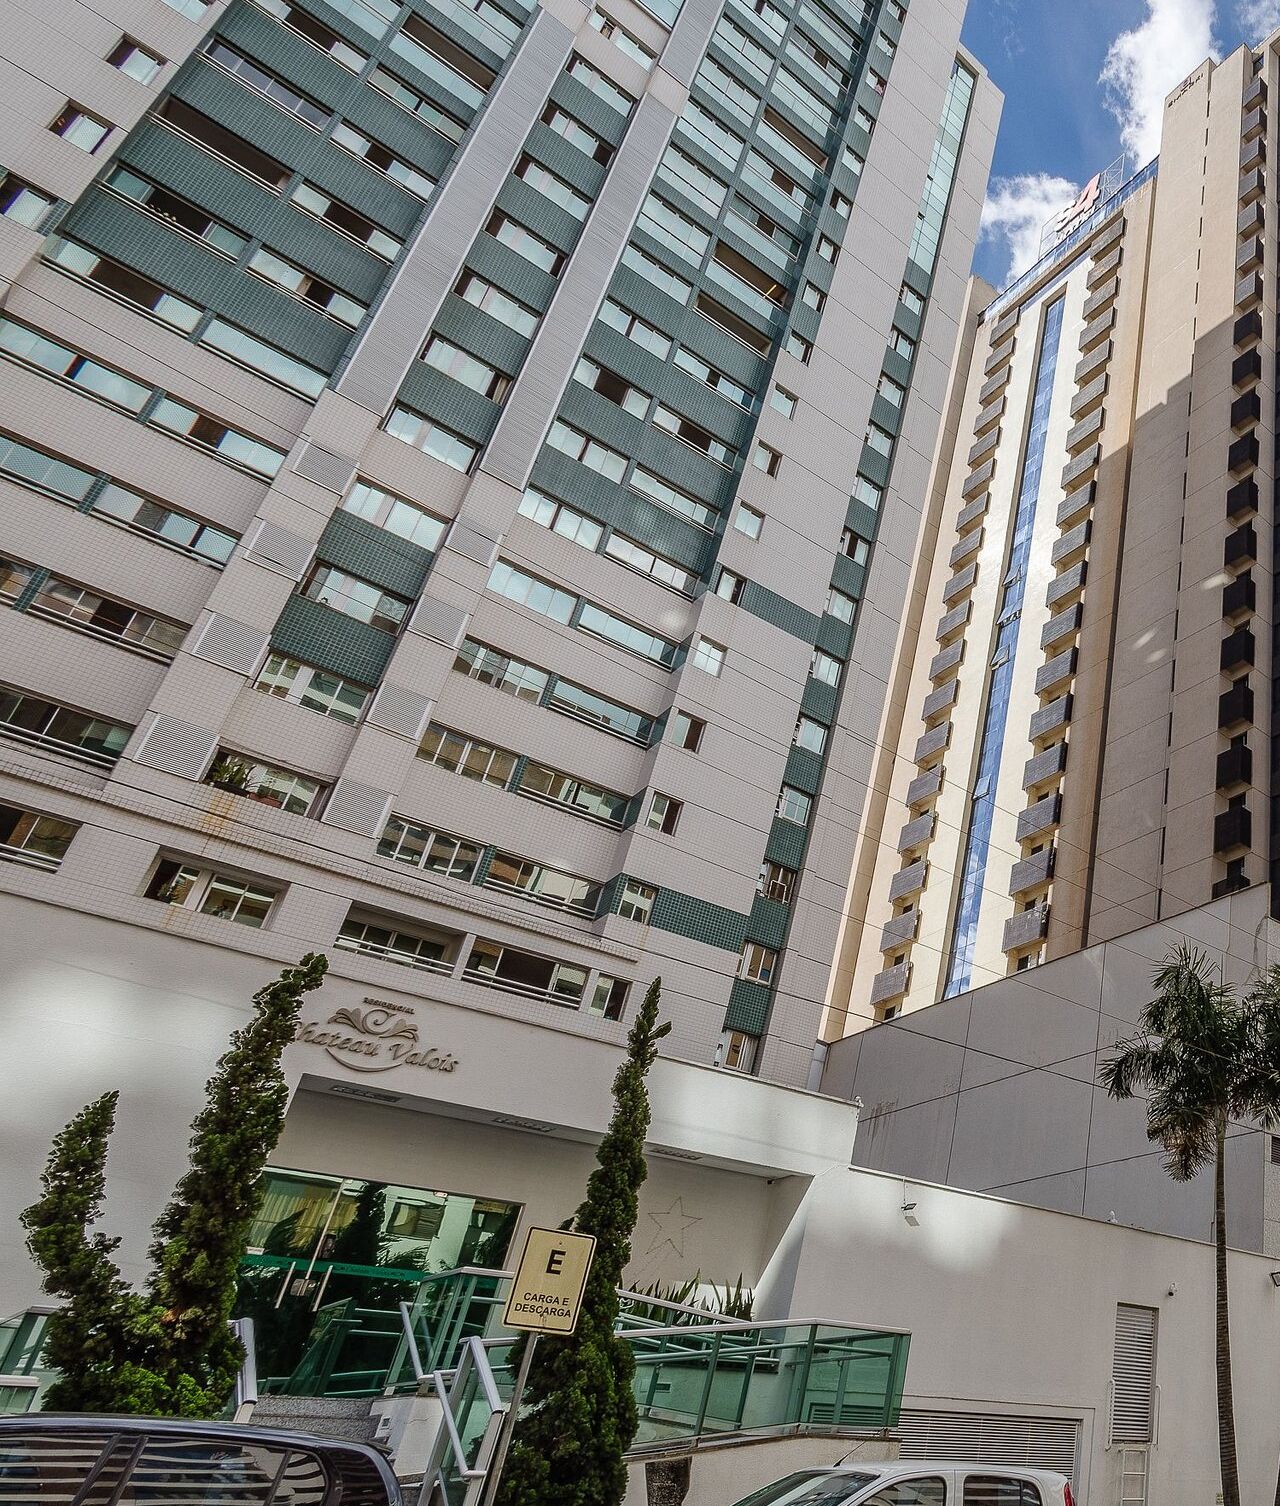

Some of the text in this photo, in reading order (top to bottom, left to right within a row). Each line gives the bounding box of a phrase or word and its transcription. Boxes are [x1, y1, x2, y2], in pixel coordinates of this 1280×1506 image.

[389, 1043, 459, 1073] Valois
[546, 1249, 567, 1275] E
[524, 1292, 570, 1306] CARGA E
[515, 1303, 571, 1318] DESCARGA
